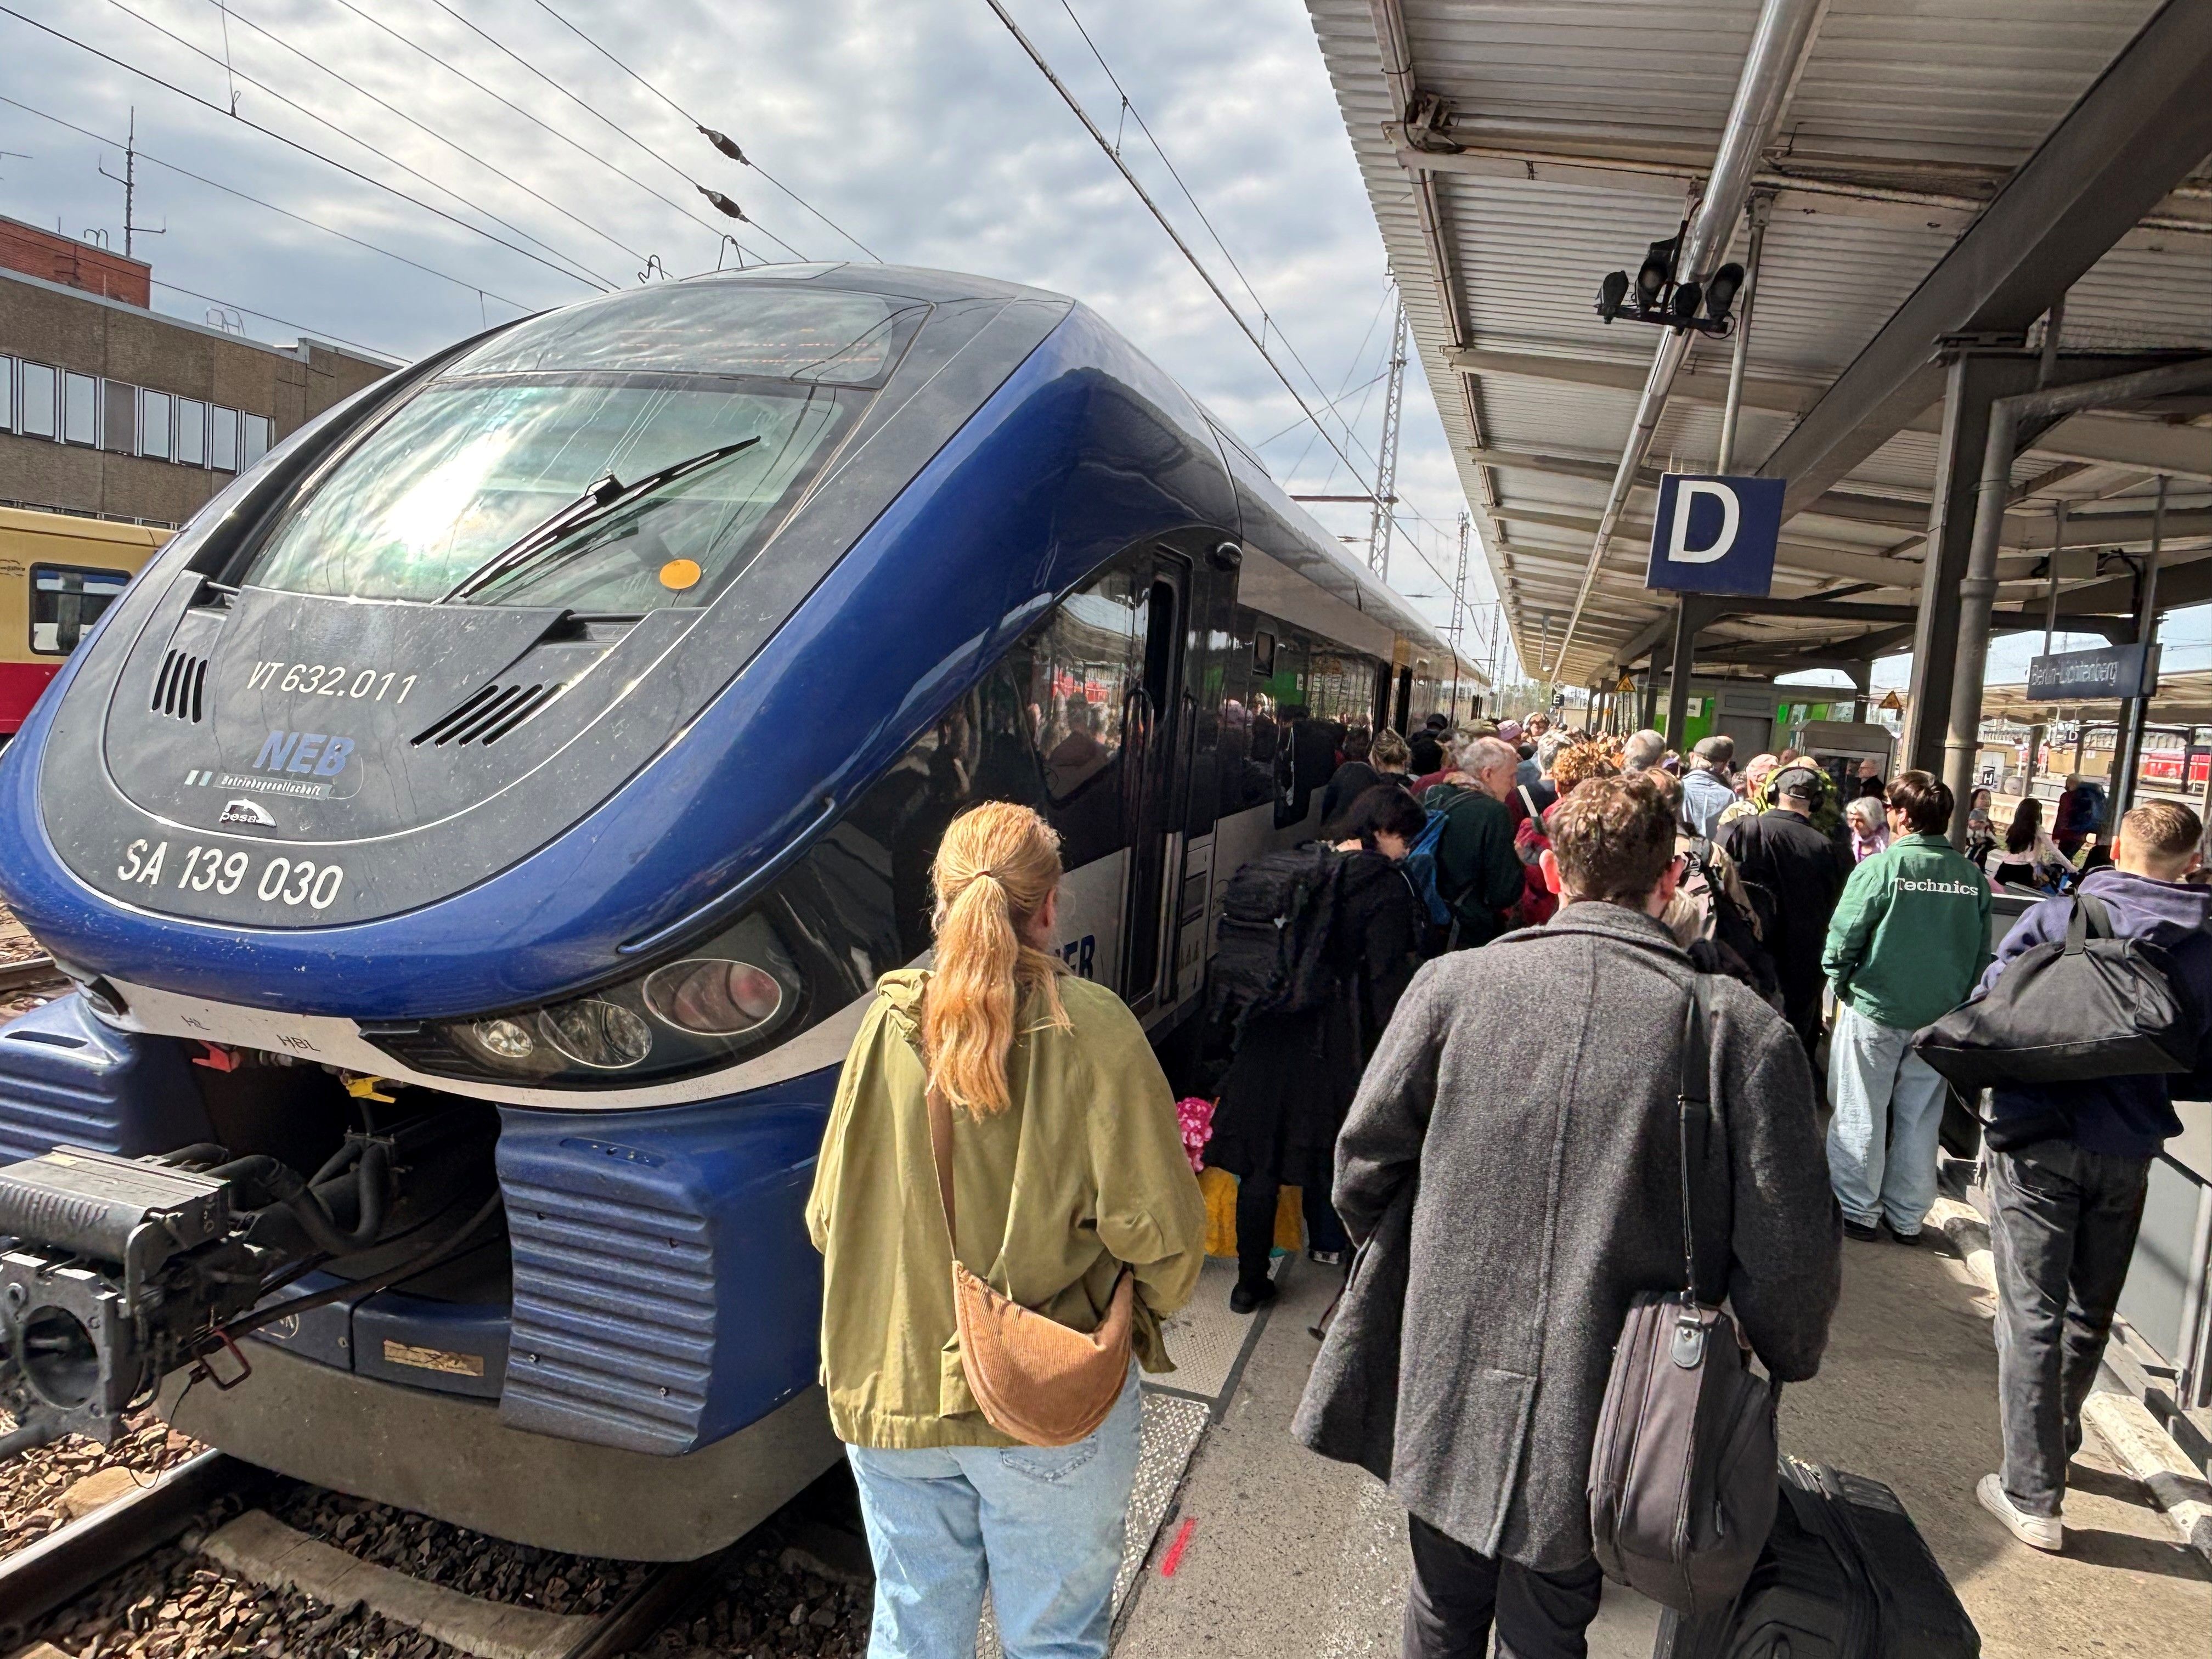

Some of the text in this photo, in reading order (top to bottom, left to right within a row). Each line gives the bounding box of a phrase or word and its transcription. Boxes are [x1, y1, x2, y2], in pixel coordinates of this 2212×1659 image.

[1668, 480, 1740, 563] D
[247, 661, 417, 704] VT 632.011
[2068, 730, 2078, 741] D
[252, 730, 356, 776] NEB
[221, 775, 321, 796] Betriebsgesellschaft
[1983, 773, 1993, 785] H
[117, 839, 343, 910] SA 139 030
[1894, 877, 1979, 896] Technics
[1055, 934, 1096, 981] EB
[276, 1034, 321, 1053] HBL
